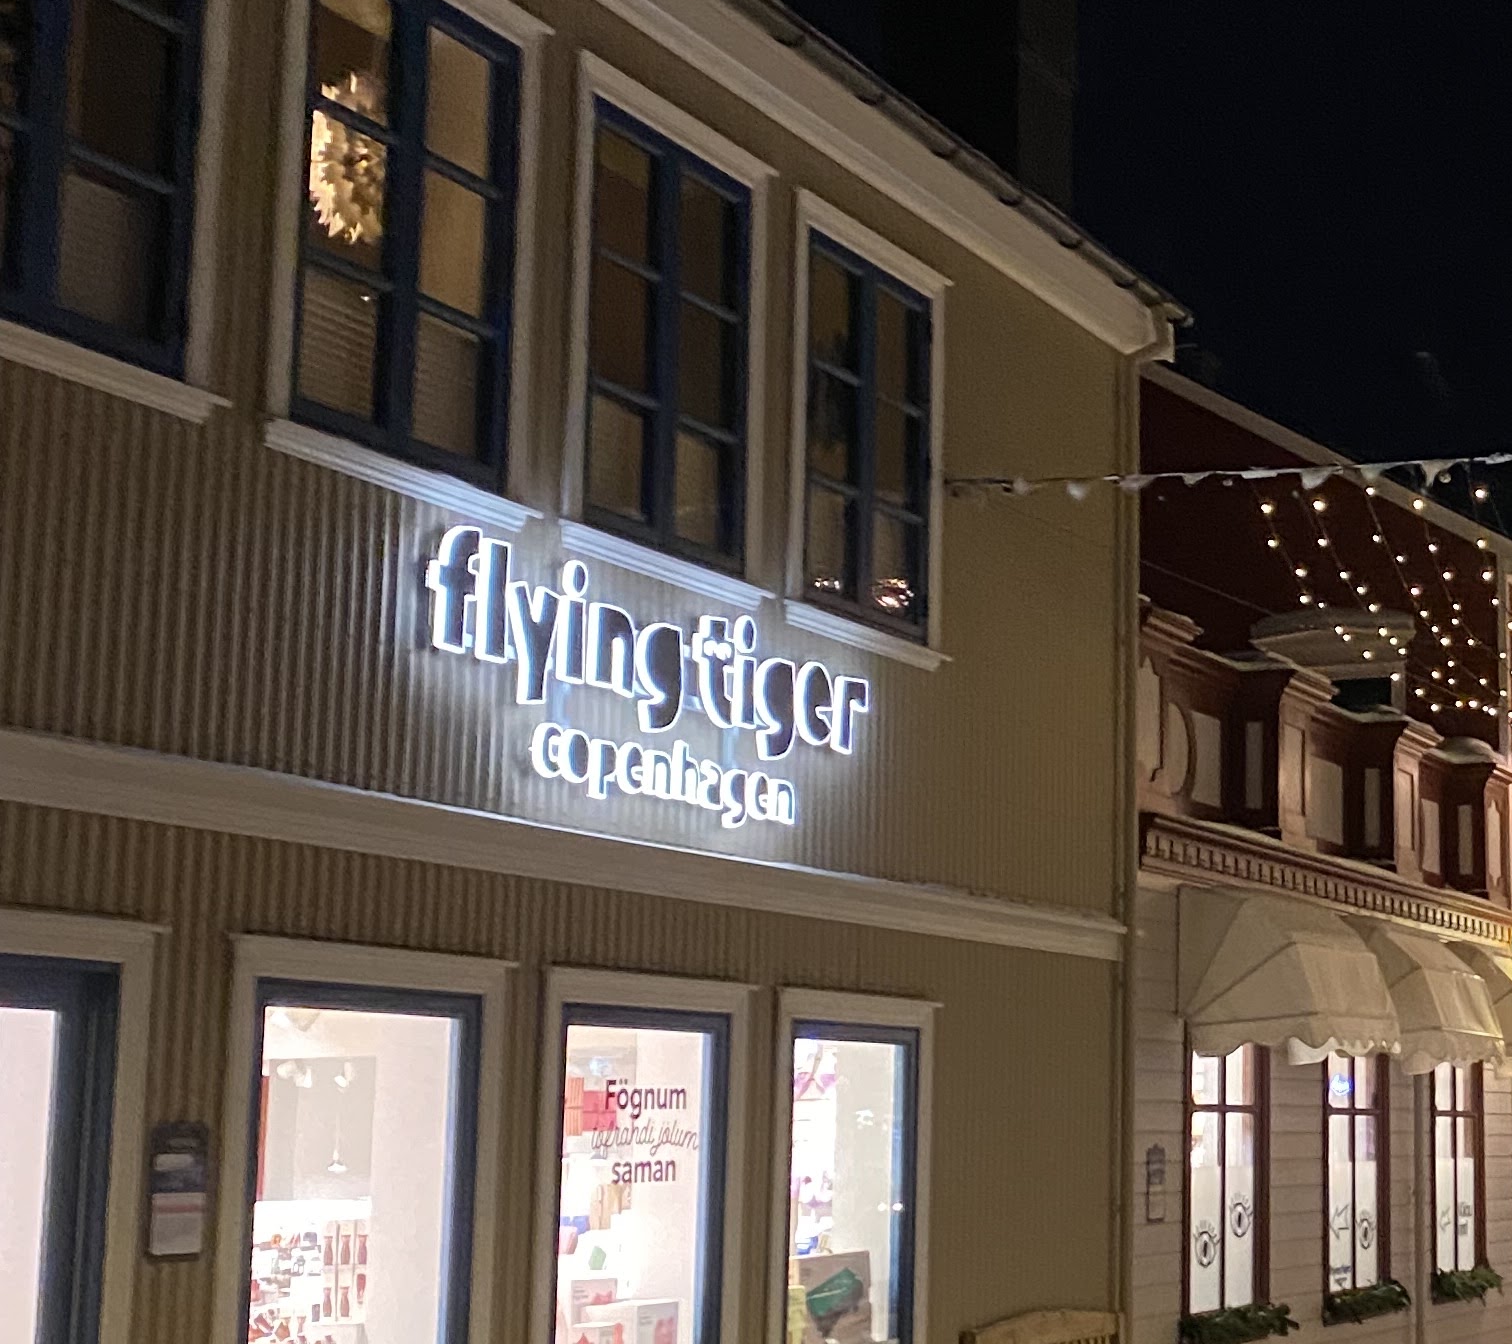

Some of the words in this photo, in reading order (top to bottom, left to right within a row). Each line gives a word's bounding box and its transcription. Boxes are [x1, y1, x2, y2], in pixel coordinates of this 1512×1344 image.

[426, 524, 684, 733] flying
[694, 614, 870, 761] tiger
[530, 722, 796, 829] copenhagen
[605, 1078, 687, 1119] Fögnum
[611, 1159, 677, 1185] saman
